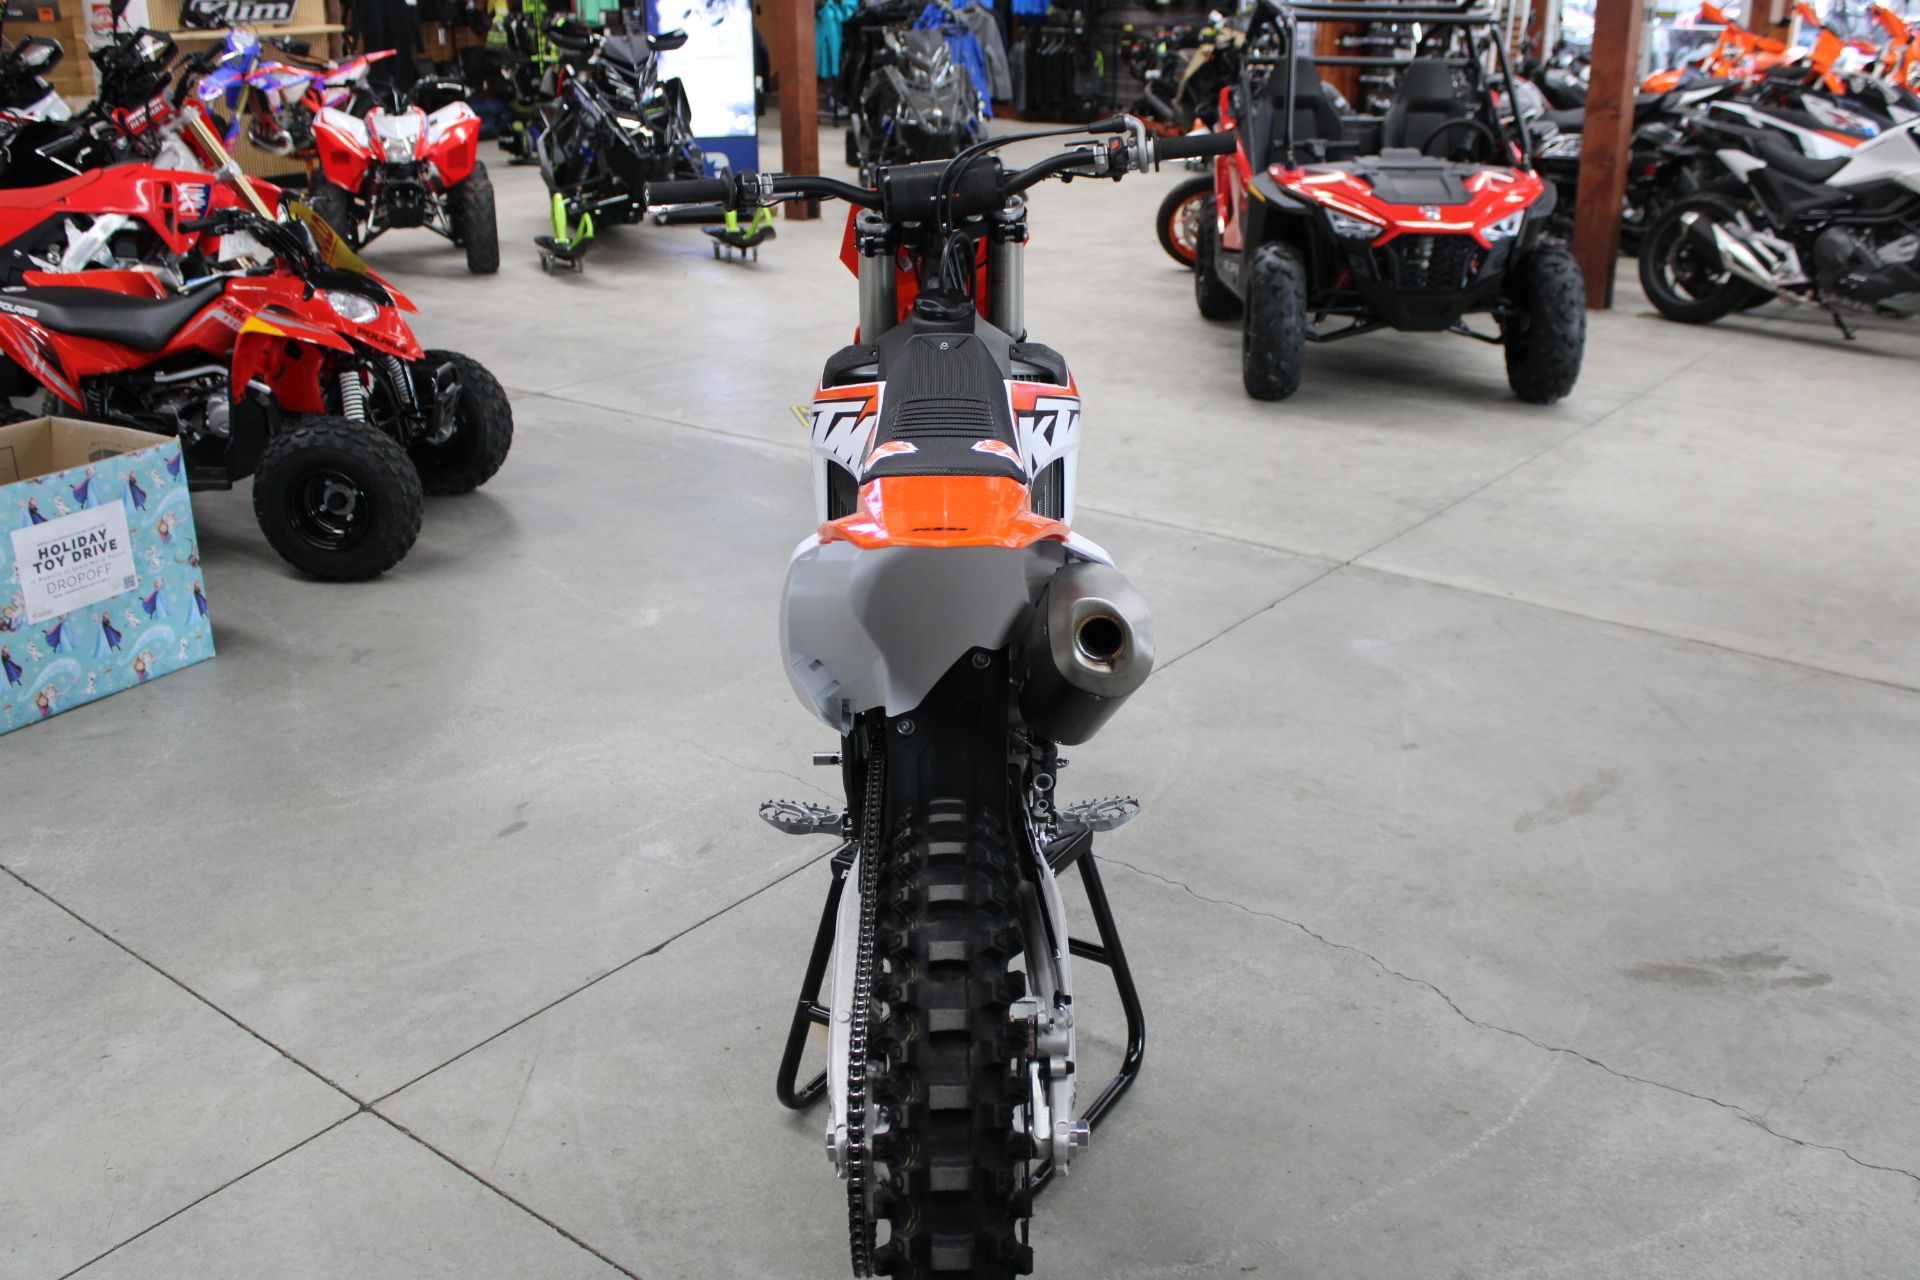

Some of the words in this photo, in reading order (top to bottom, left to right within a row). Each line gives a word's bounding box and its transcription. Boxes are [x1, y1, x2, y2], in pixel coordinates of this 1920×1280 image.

[811, 400, 878, 472] TM
[32, 555, 65, 574] TOY
[72, 539, 118, 562] DRIVE
[38, 528, 107, 560] HOLIDAY
[46, 562, 112, 595] DROPOFF
